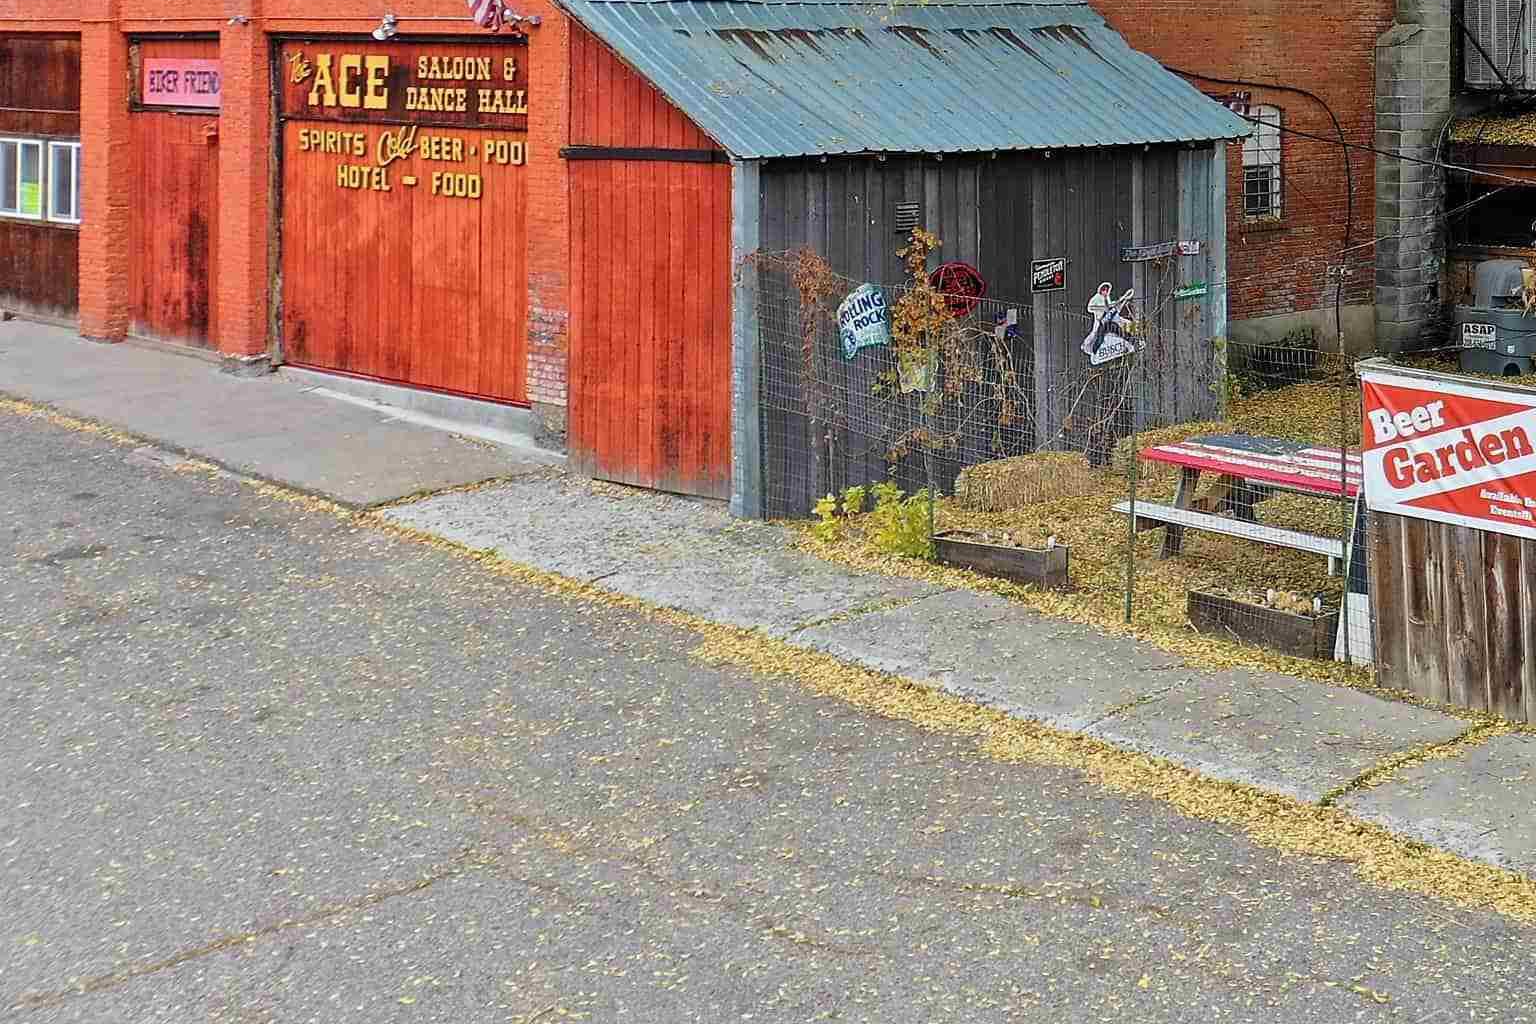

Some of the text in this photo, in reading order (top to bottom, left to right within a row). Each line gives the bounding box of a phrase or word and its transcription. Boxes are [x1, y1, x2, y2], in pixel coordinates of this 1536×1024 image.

[149, 70, 178, 93] BIKER
[308, 54, 389, 110] ACE
[417, 55, 516, 81] SALOON &
[405, 87, 528, 114] DANCE HALL
[299, 129, 365, 156] SPIRITS
[377, 125, 419, 166] Cold
[420, 135, 463, 162] BEER
[337, 164, 392, 192] HOTEL
[431, 171, 481, 198] FOOD
[840, 290, 884, 328] ROLLING
[853, 308, 887, 331] ROCK
[1464, 324, 1495, 335] ASAP
[1368, 400, 1446, 445] Beer
[1383, 426, 1535, 490] Garden
